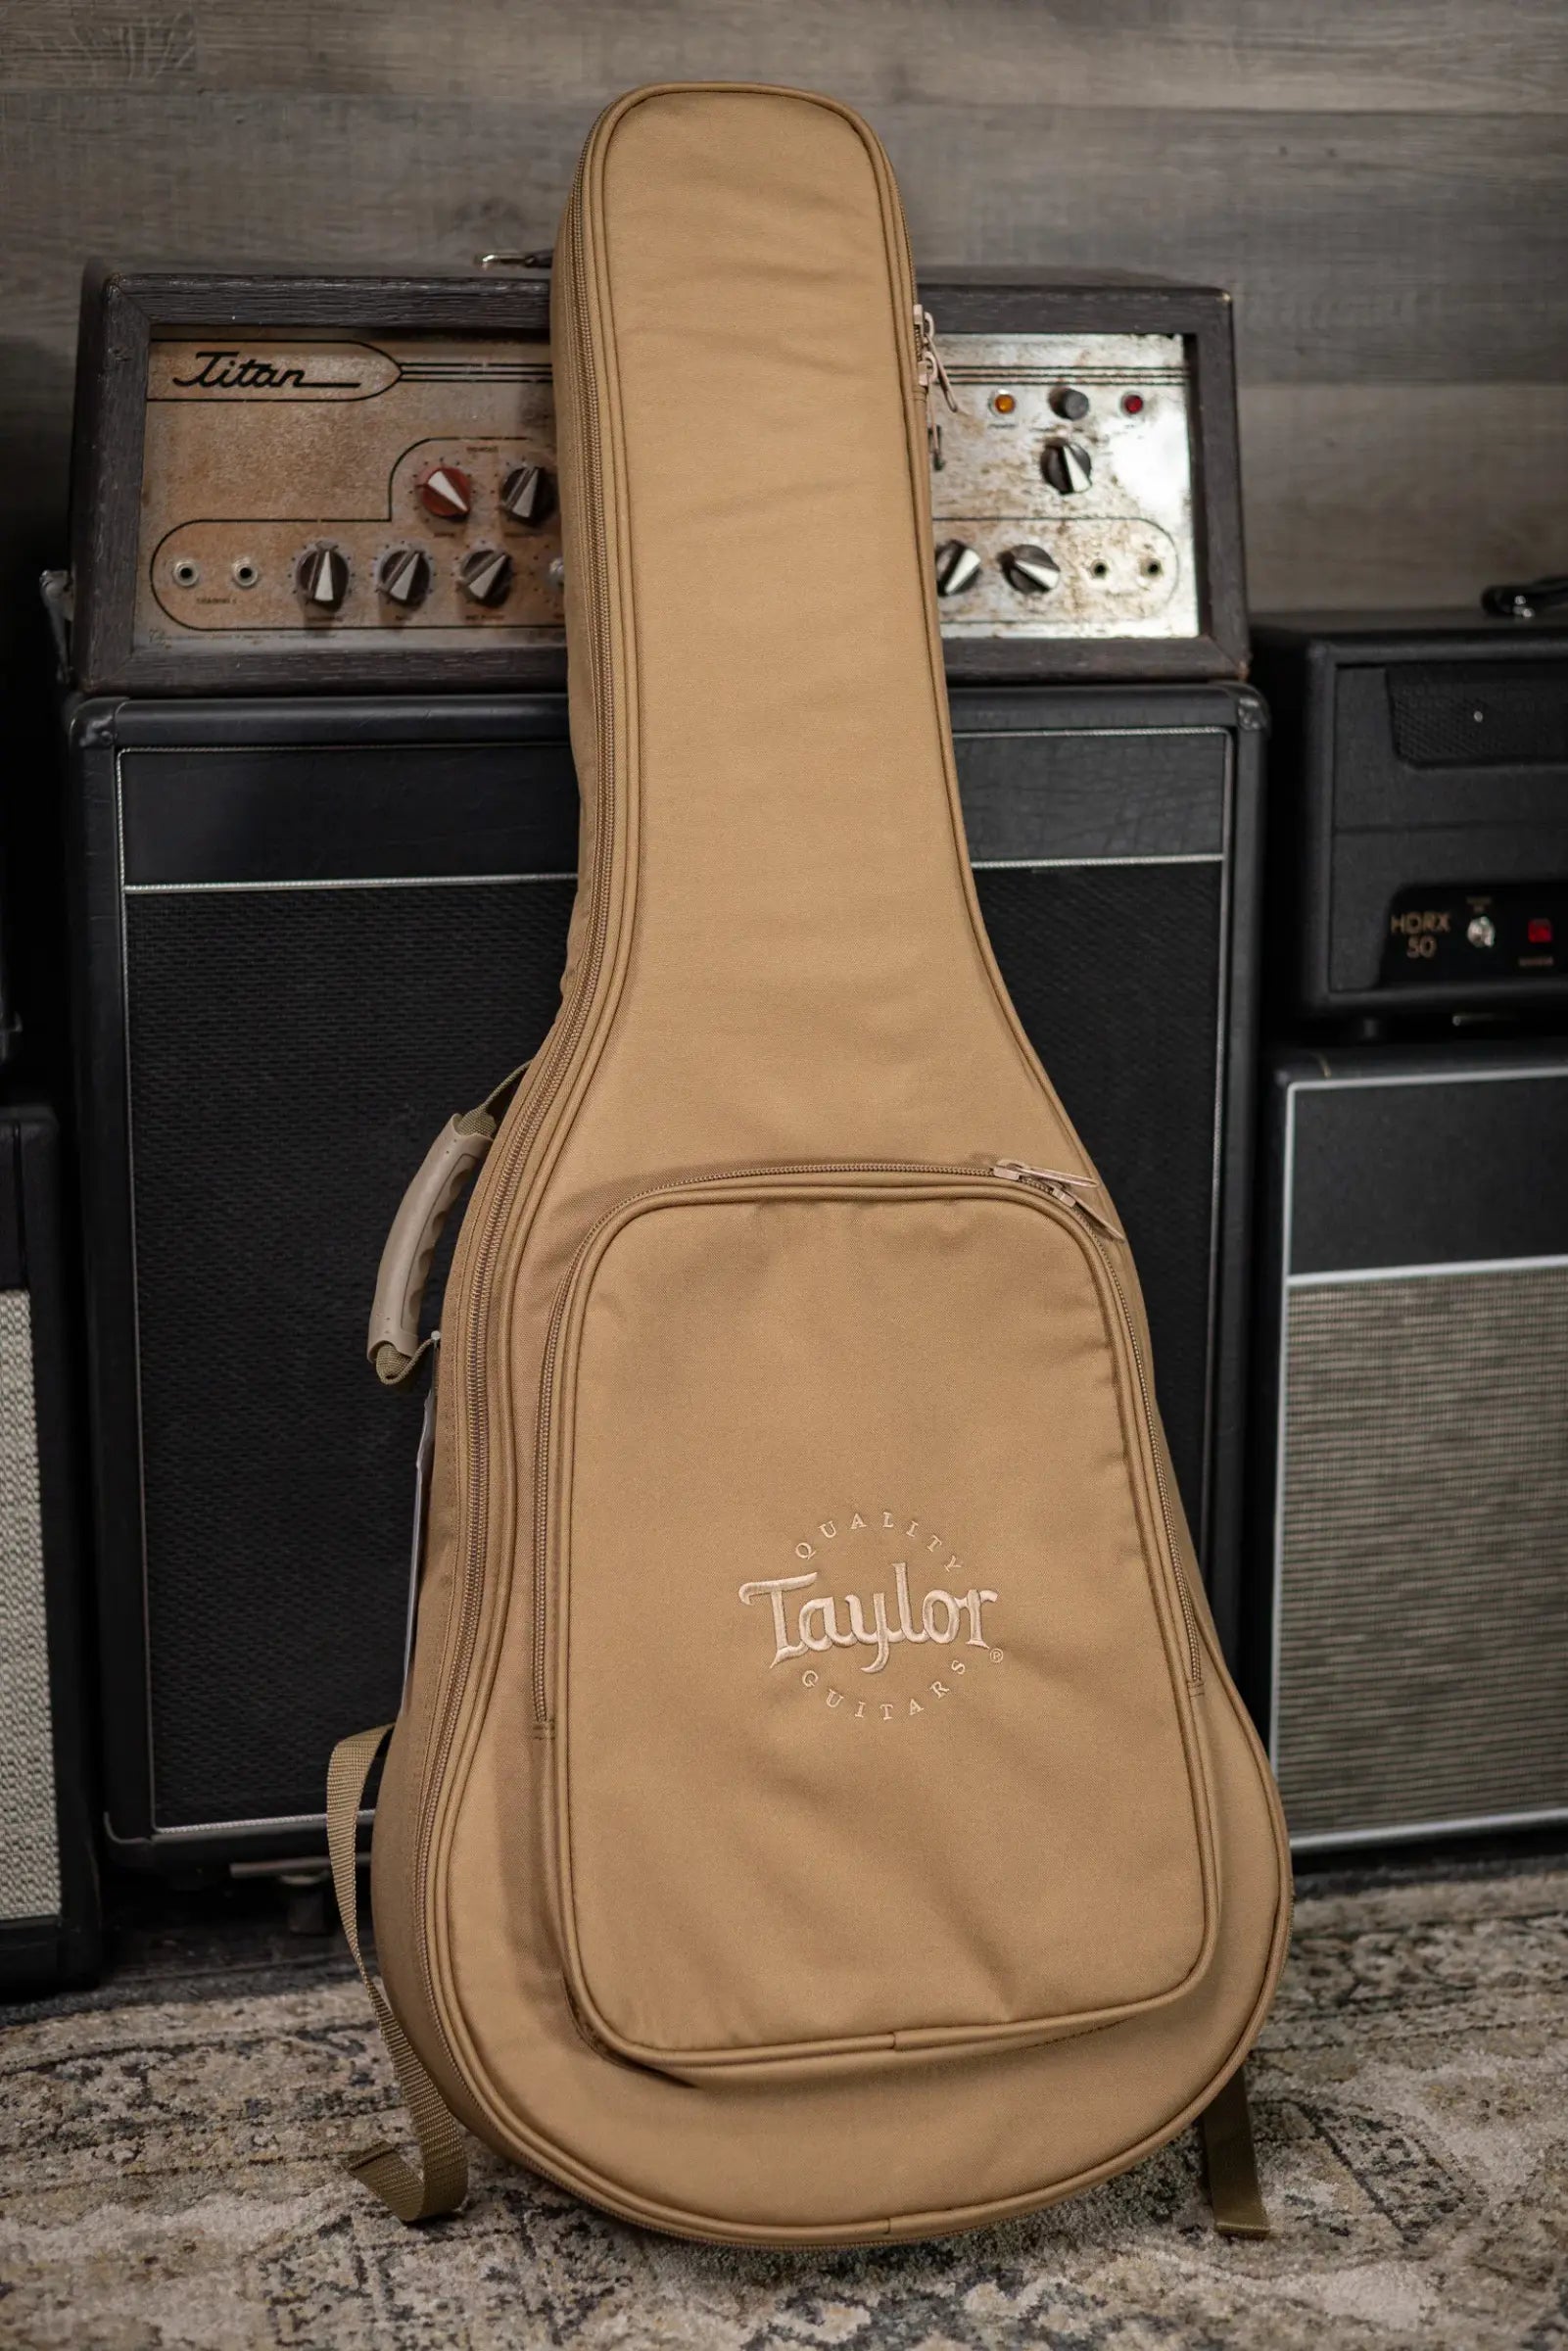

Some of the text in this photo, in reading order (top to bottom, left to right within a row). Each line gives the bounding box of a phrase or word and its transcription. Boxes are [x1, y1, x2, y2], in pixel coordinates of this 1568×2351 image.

[172, 351, 361, 388] Titan
[1406, 936, 1438, 959] 50
[795, 1511, 962, 1572] QUALITY
[737, 1562, 999, 1673] Taylor
[801, 1659, 966, 1720] GUITARS
